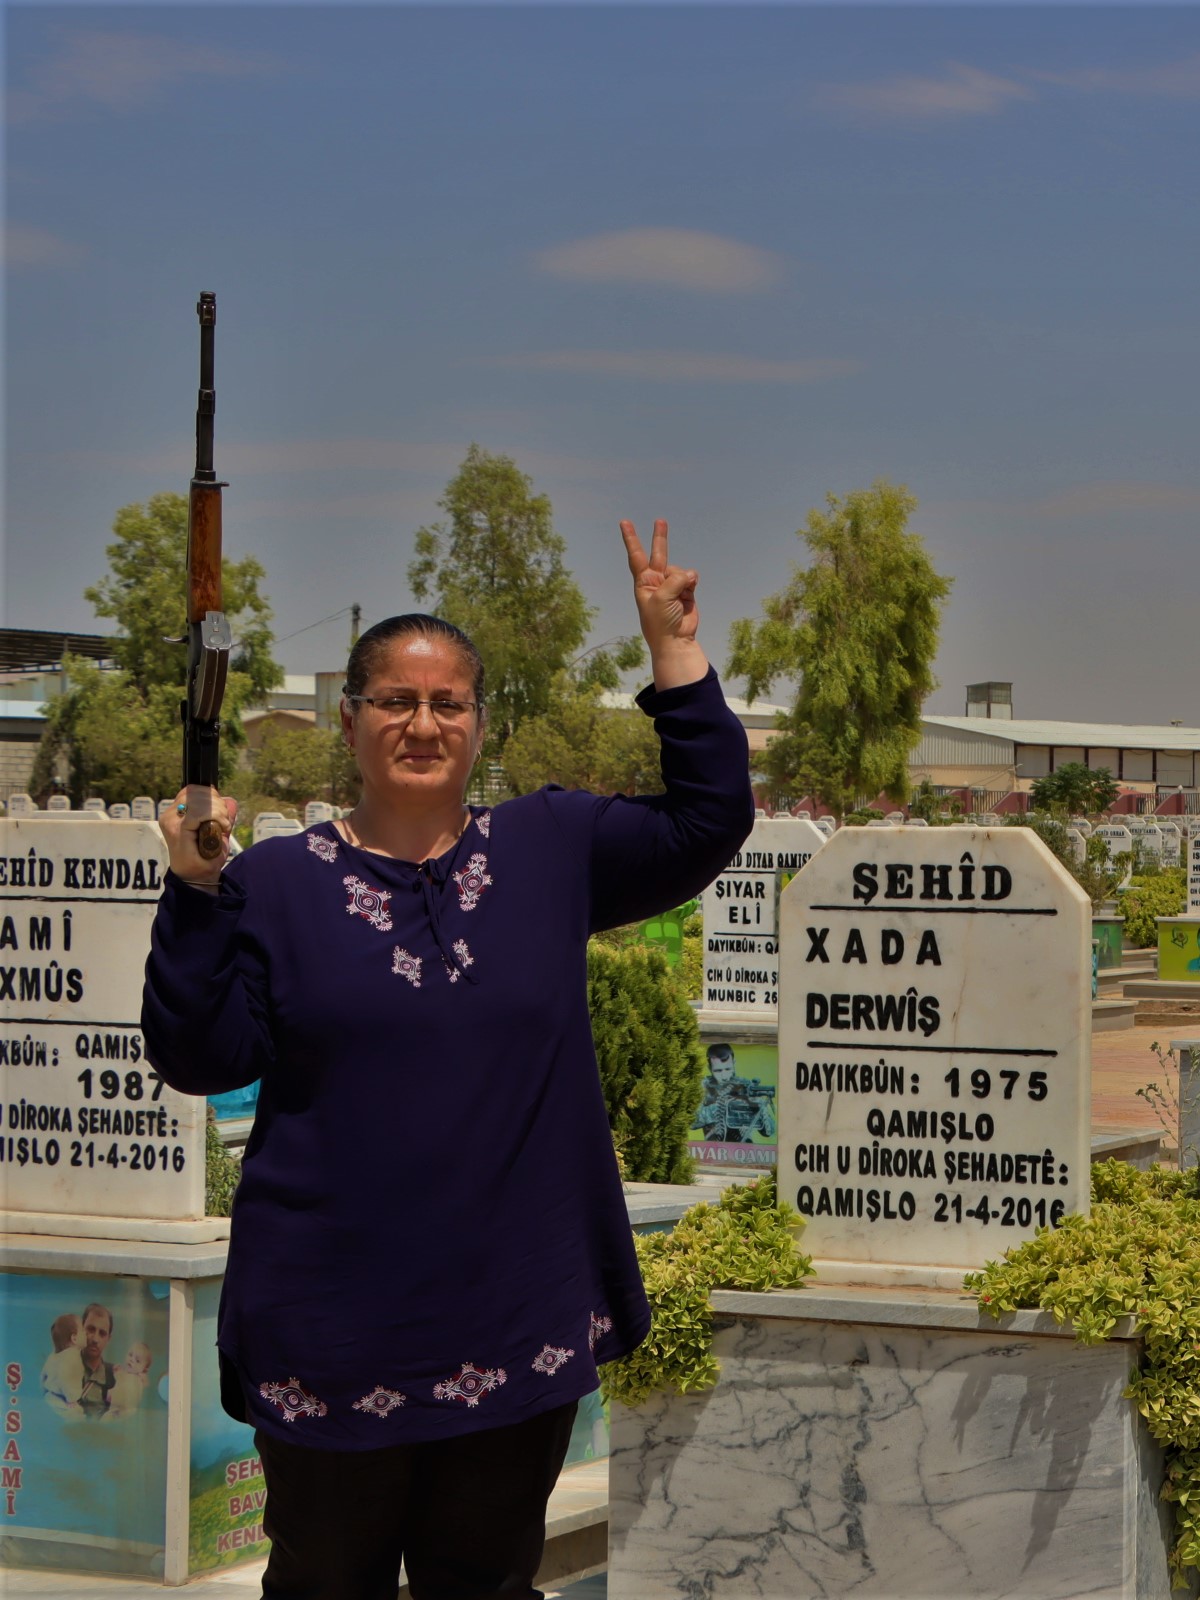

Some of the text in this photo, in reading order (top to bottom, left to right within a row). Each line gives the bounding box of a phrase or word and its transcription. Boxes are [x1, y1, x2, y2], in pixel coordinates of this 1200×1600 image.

[64, 858, 161, 890] KENDAL
[746, 852, 774, 868] DIYAR
[715, 880, 765, 899] ŞIYAR
[852, 852, 1013, 905] ŞEHÎD
[729, 902, 760, 924] ELÎ
[806, 927, 942, 966] XADA
[707, 968, 723, 982] CIH
[726, 967, 732, 982] Û
[735, 968, 768, 984] DÎROKA
[708, 988, 756, 1003] MUNBIC
[806, 987, 941, 1036] DERWÎŞ
[77, 1068, 165, 1101] 1987
[944, 1067, 1048, 1101] 1975
[9, 1098, 72, 1132] DÎROKA
[866, 1109, 995, 1144] QAMIŞLO
[794, 1143, 830, 1174] CIH
[837, 1146, 851, 1174] U
[858, 1141, 936, 1179] DÎROKA
[796, 1186, 1065, 1229] QAMIŞLO 21-4-2016
